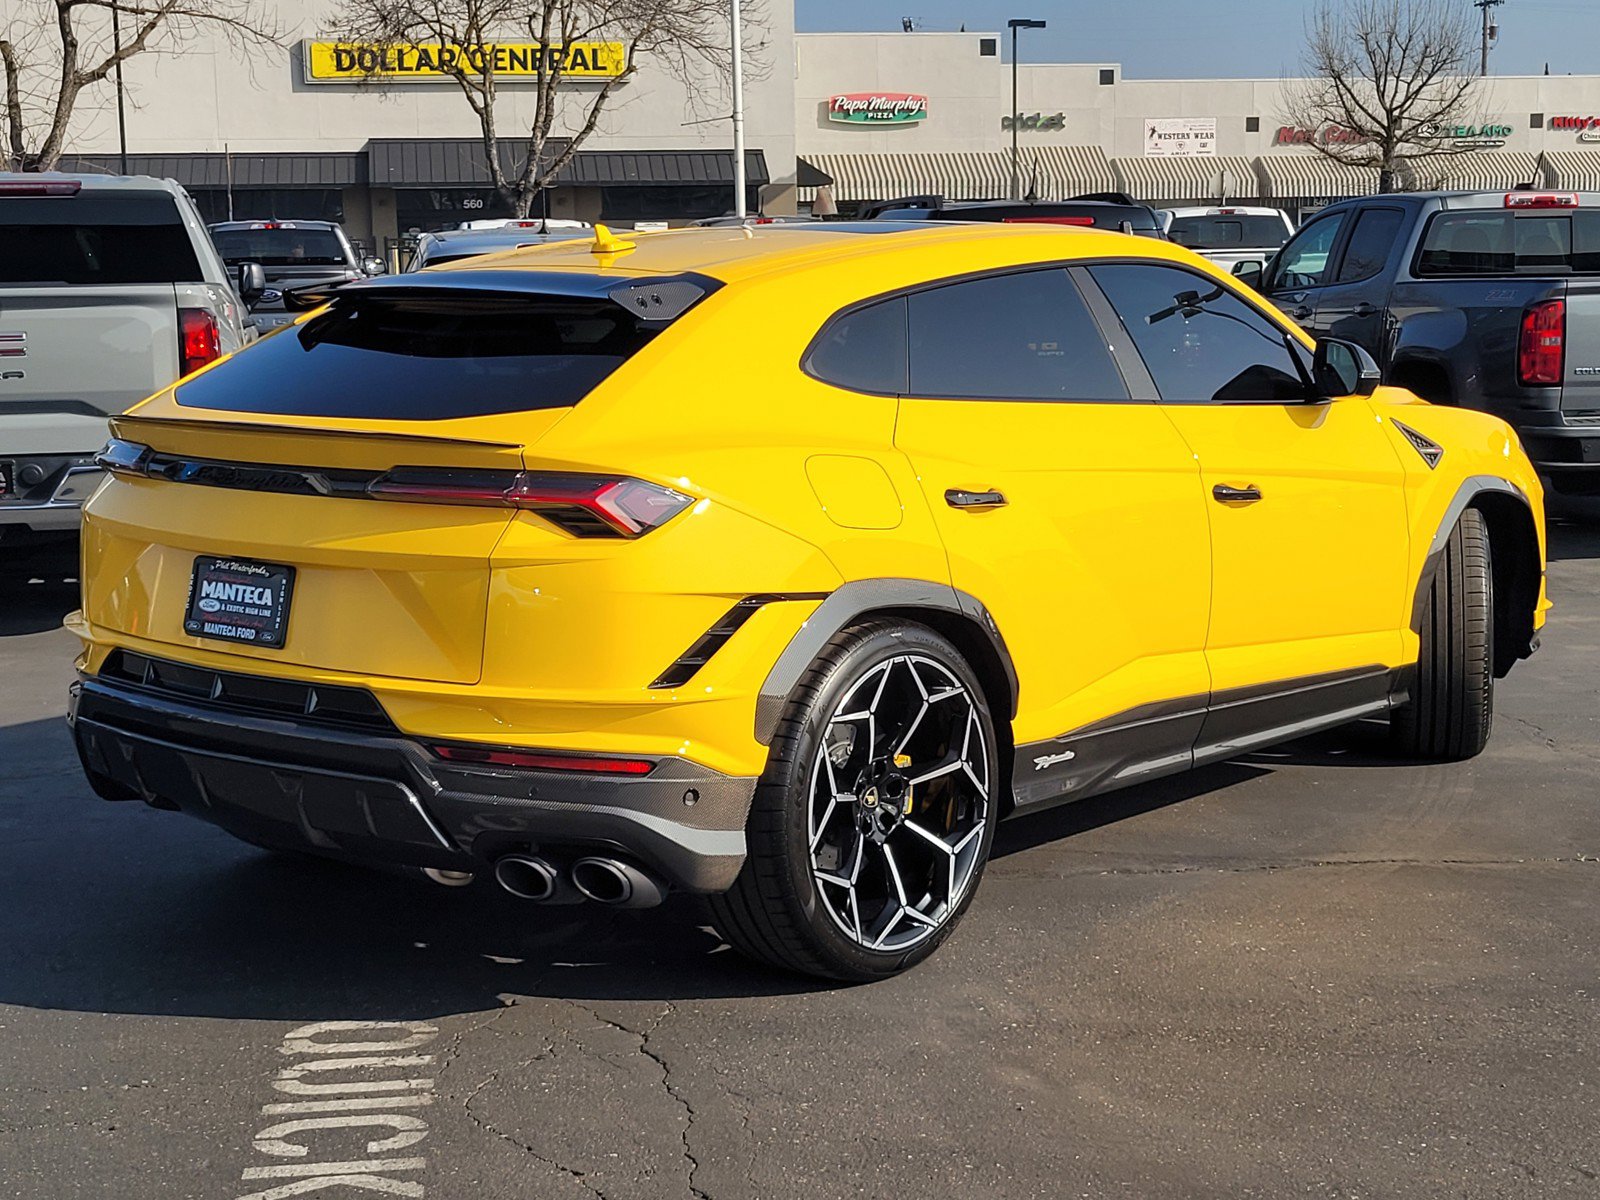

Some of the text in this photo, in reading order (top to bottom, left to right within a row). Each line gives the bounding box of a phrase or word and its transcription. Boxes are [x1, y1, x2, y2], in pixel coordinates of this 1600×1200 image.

[335, 47, 457, 71] DOLLAR
[834, 95, 927, 115] Papa Murphy's
[1157, 132, 1215, 140] WESTERN WEAR
[463, 199, 483, 209] 560
[201, 580, 273, 606] MANTECA
[203, 622, 256, 640] MANTECA FORD
